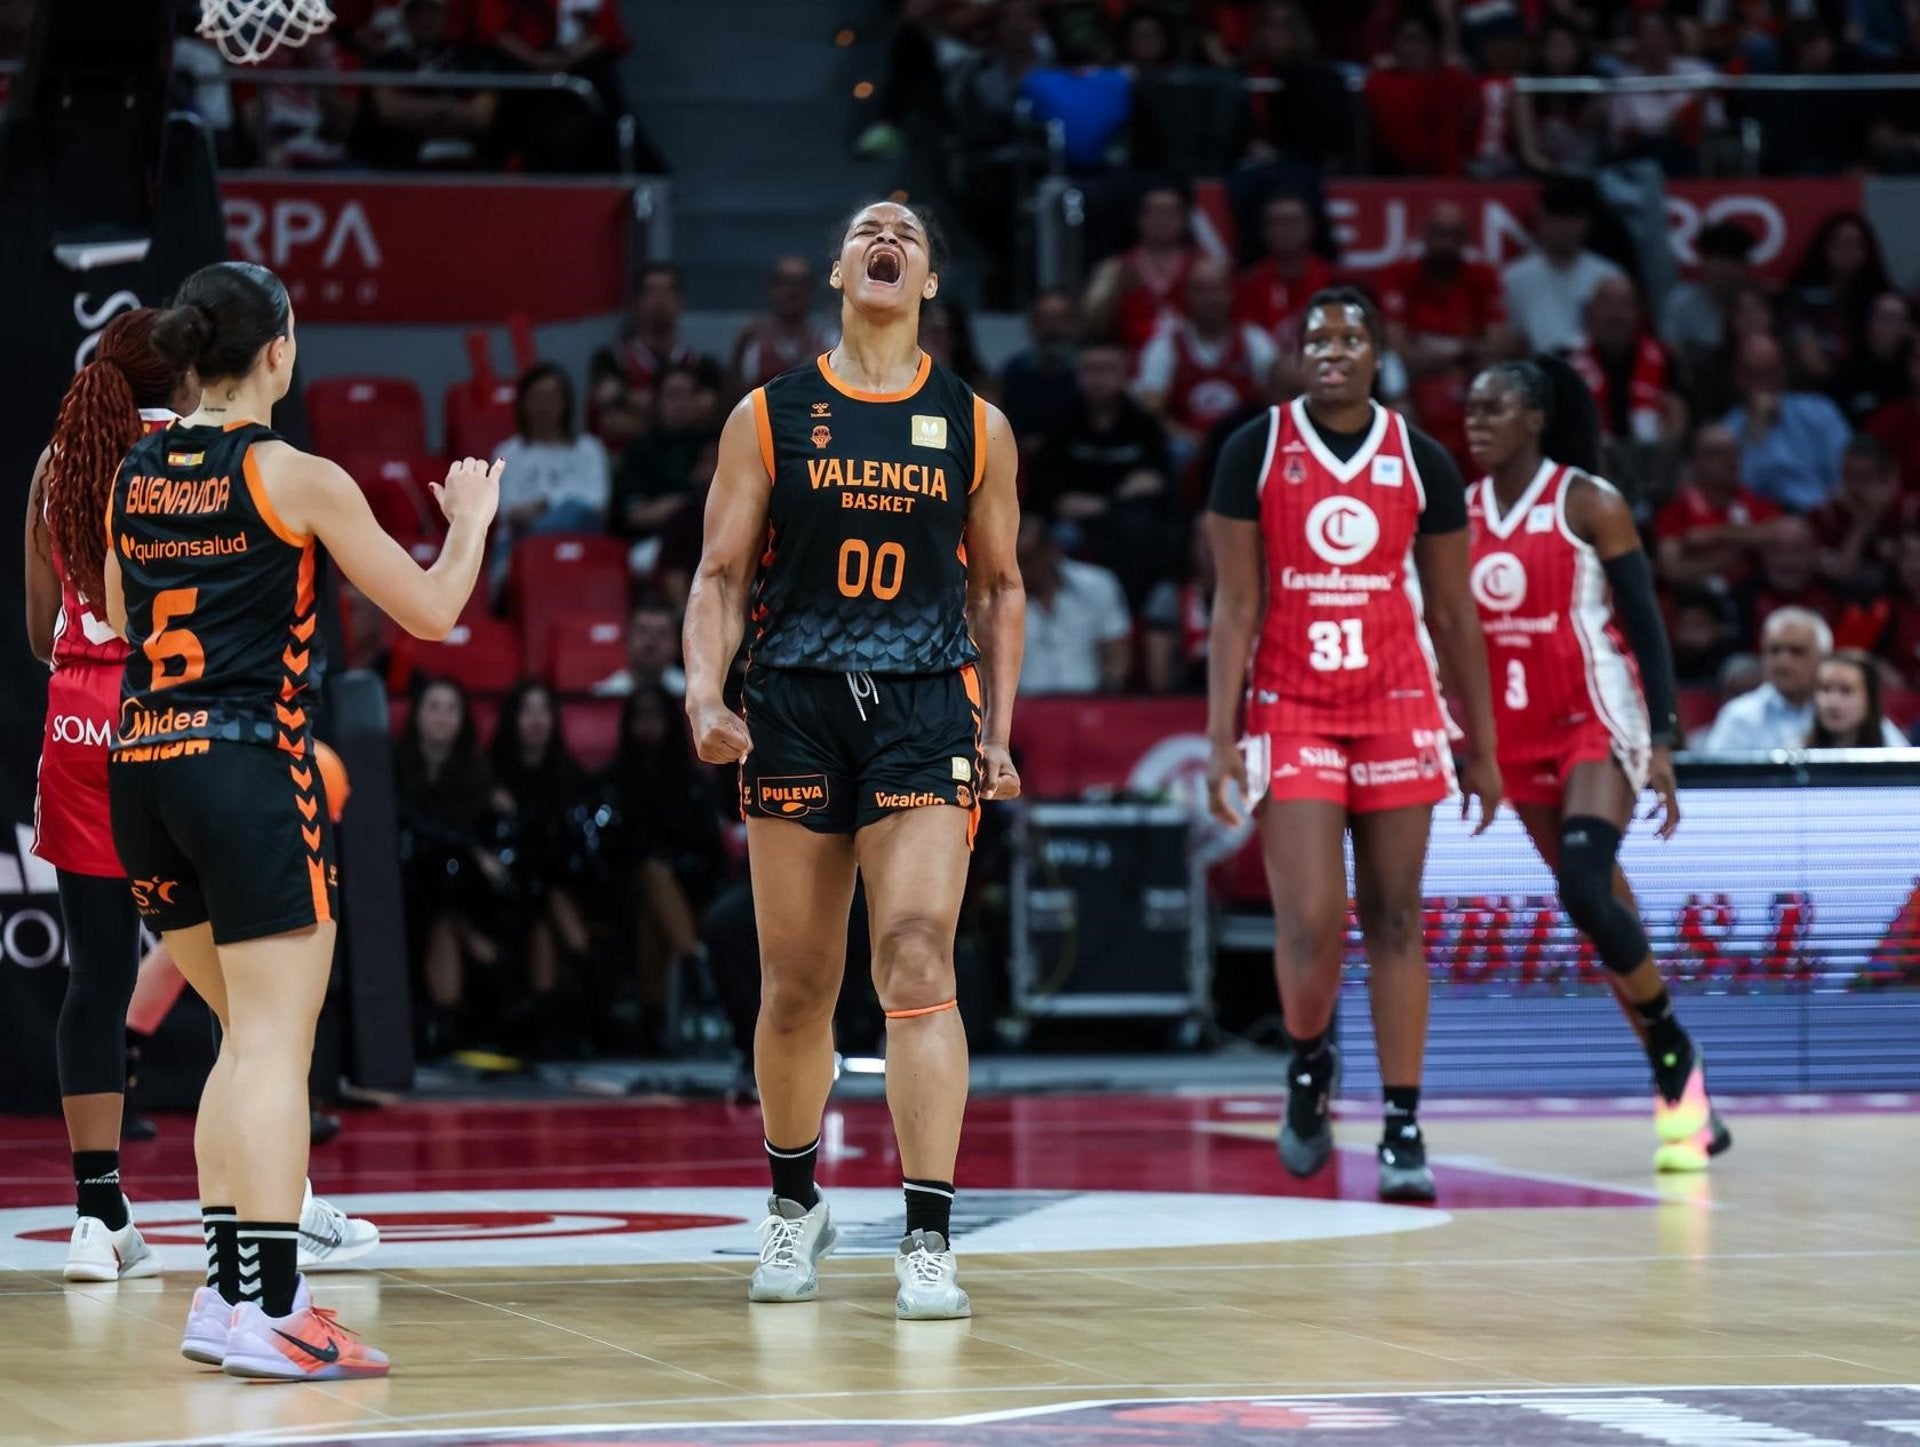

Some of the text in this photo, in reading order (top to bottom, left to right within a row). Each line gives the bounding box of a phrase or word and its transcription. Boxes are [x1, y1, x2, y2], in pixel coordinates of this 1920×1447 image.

[125, 475, 231, 515] BUENAVIDA
[807, 458, 948, 502] VALENCIA
[841, 492, 916, 514] BASKET
[837, 538, 906, 601] 00
[142, 587, 205, 692] 6
[1307, 618, 1370, 672] 31
[1504, 658, 1530, 710] 3
[126, 706, 209, 740] Midea
[762, 785, 824, 801] PULEVA
